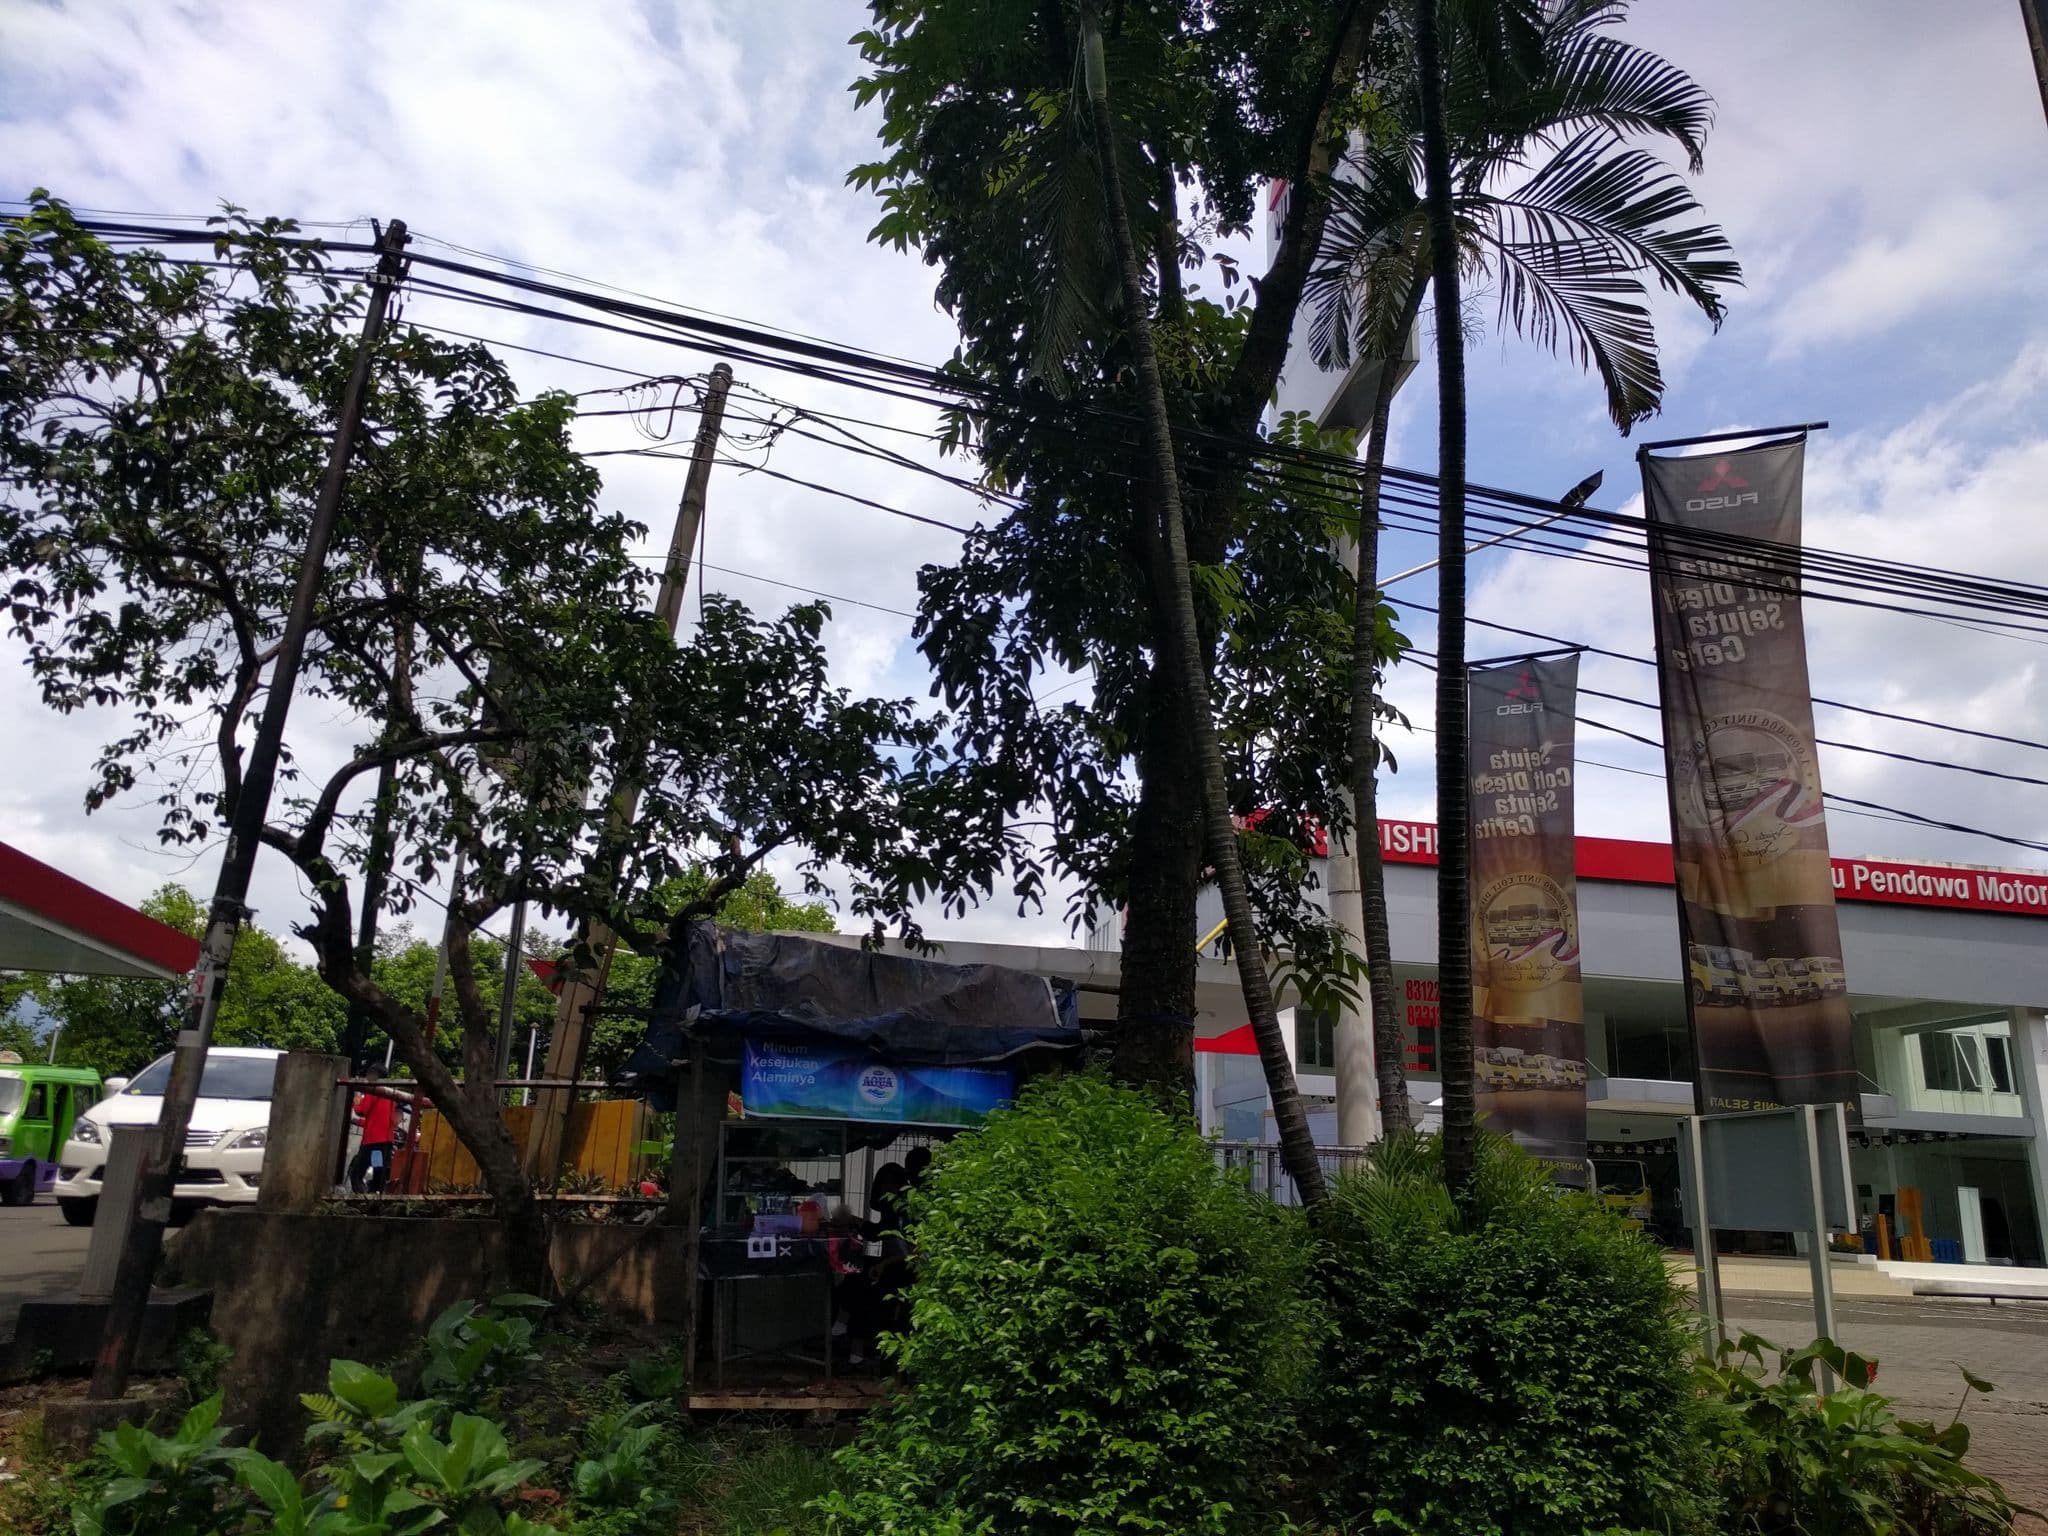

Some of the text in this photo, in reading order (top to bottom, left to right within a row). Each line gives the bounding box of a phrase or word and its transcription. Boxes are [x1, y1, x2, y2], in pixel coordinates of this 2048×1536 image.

[1383, 823, 1439, 855] ISHI
[1831, 864, 2048, 907] u Pendawa Motor
[763, 1042, 808, 1055] Minum
[750, 1056, 818, 1070] Kesejukan
[752, 1071, 816, 1086] Alaminya
[862, 1075, 894, 1090] AQUA
